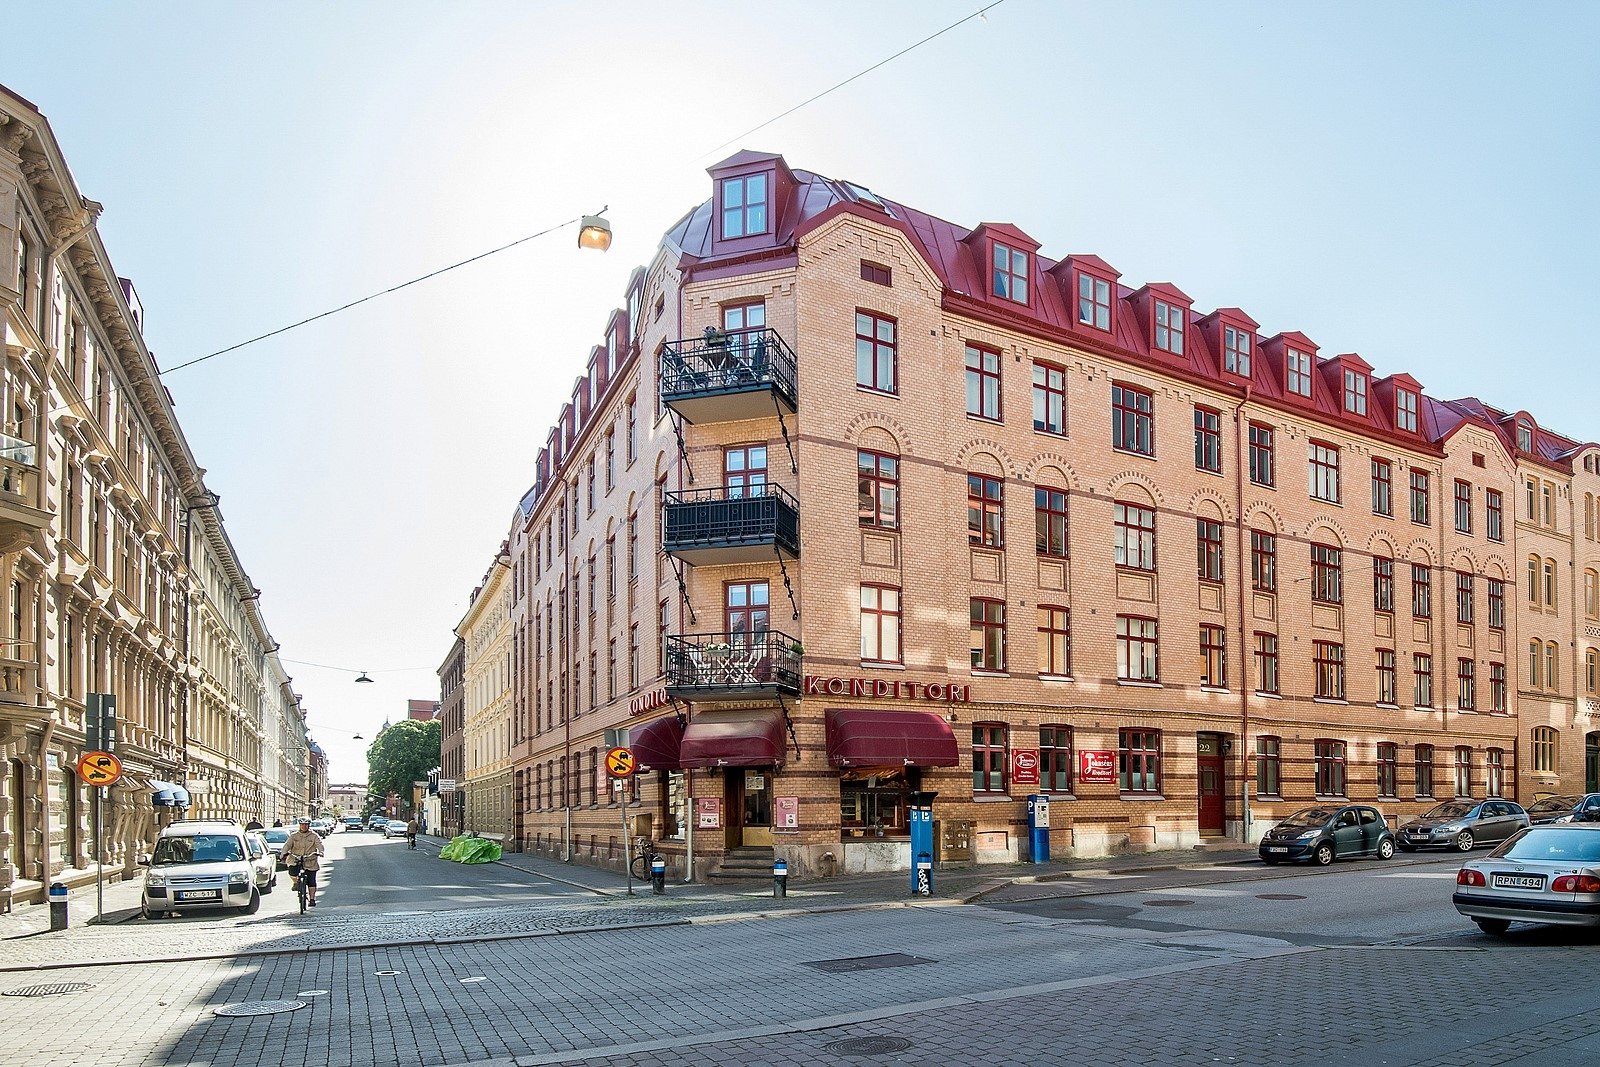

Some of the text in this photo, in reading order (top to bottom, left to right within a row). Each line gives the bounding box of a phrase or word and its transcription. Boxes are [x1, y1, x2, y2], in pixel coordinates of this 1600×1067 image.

[804, 675, 972, 703] KONDITORI
[1199, 743, 1210, 752] 22
[1496, 876, 1541, 887] RPN 494
